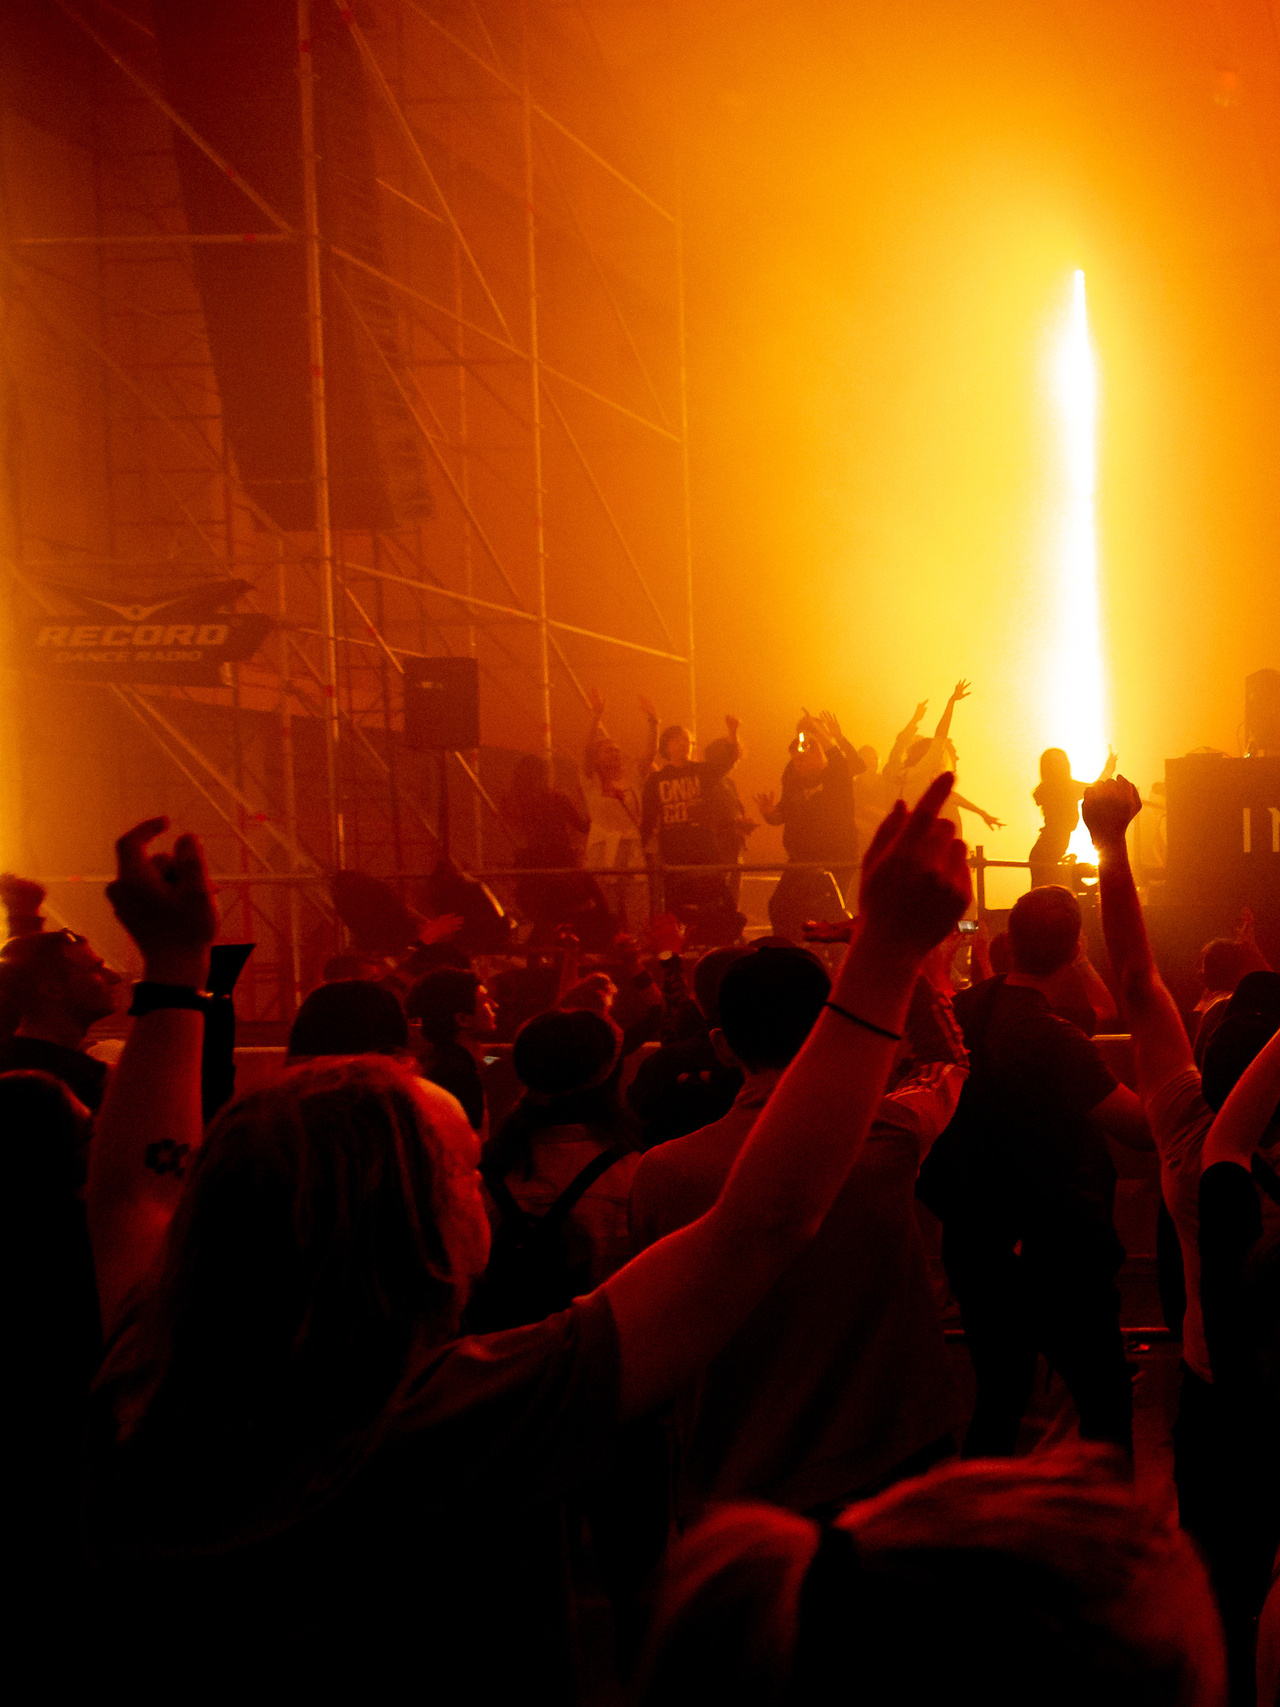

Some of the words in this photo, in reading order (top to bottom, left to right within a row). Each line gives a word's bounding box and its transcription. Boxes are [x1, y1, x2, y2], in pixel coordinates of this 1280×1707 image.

[35, 624, 229, 647] RECORD
[54, 651, 130, 663] DANCE
[134, 650, 204, 662] RADIO
